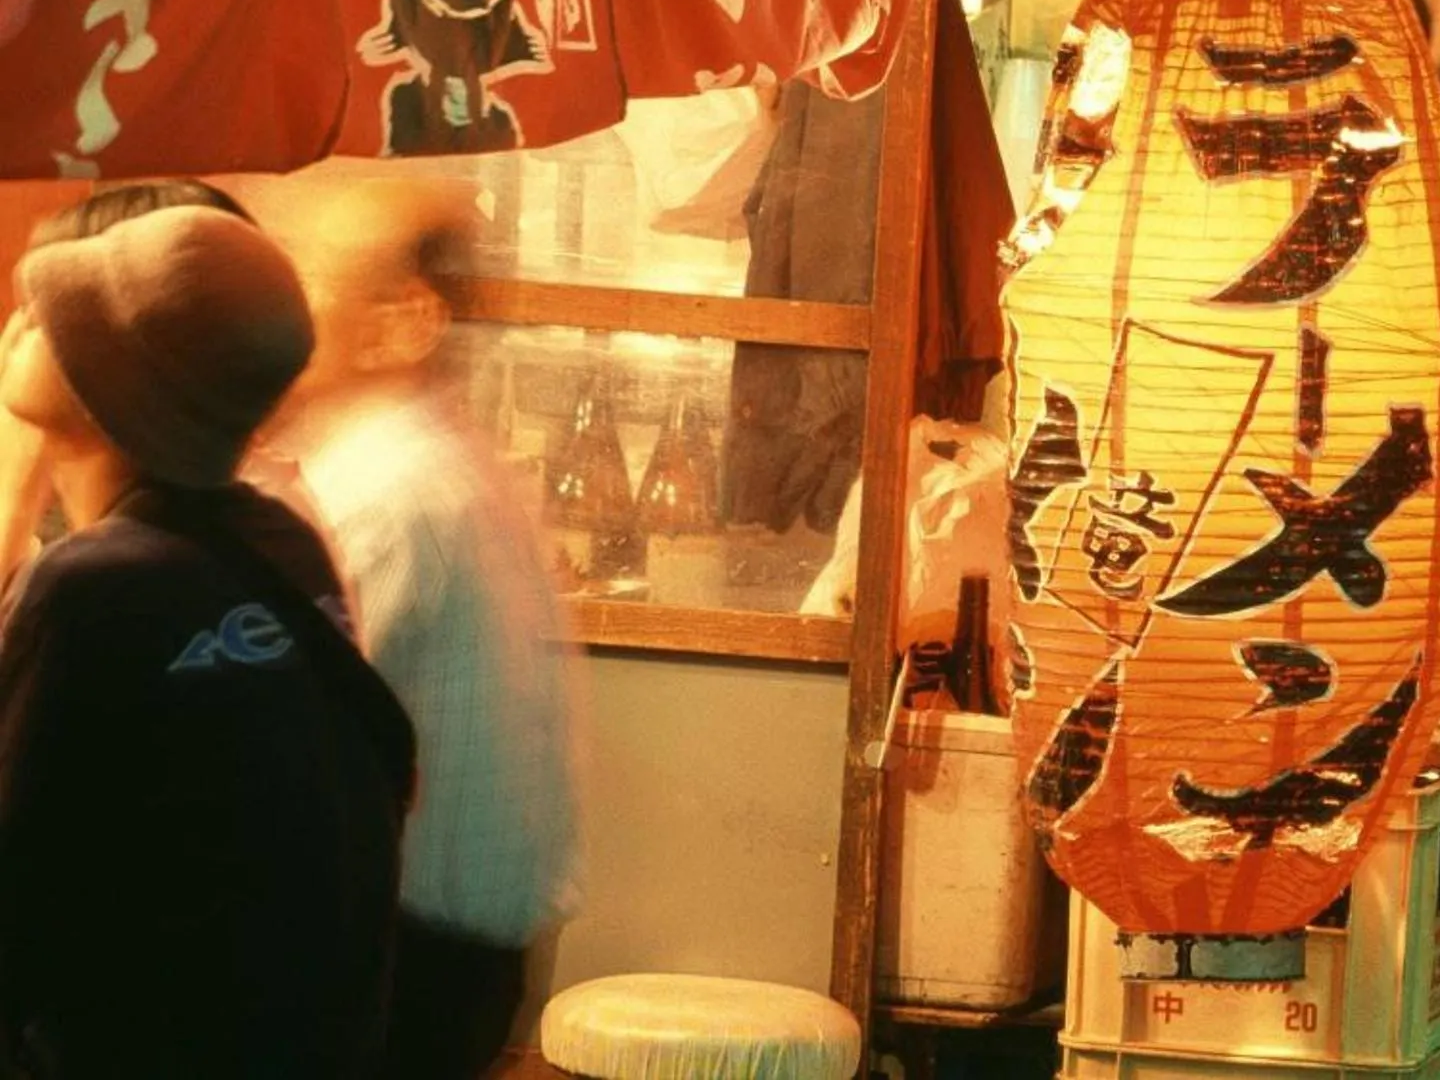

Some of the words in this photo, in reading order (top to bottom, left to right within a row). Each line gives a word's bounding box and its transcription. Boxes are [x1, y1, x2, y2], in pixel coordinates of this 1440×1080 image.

[1153, 34, 1434, 828] ラーメン
[1153, 991, 1183, 1024] 中
[1285, 1001, 1317, 1032] 20
